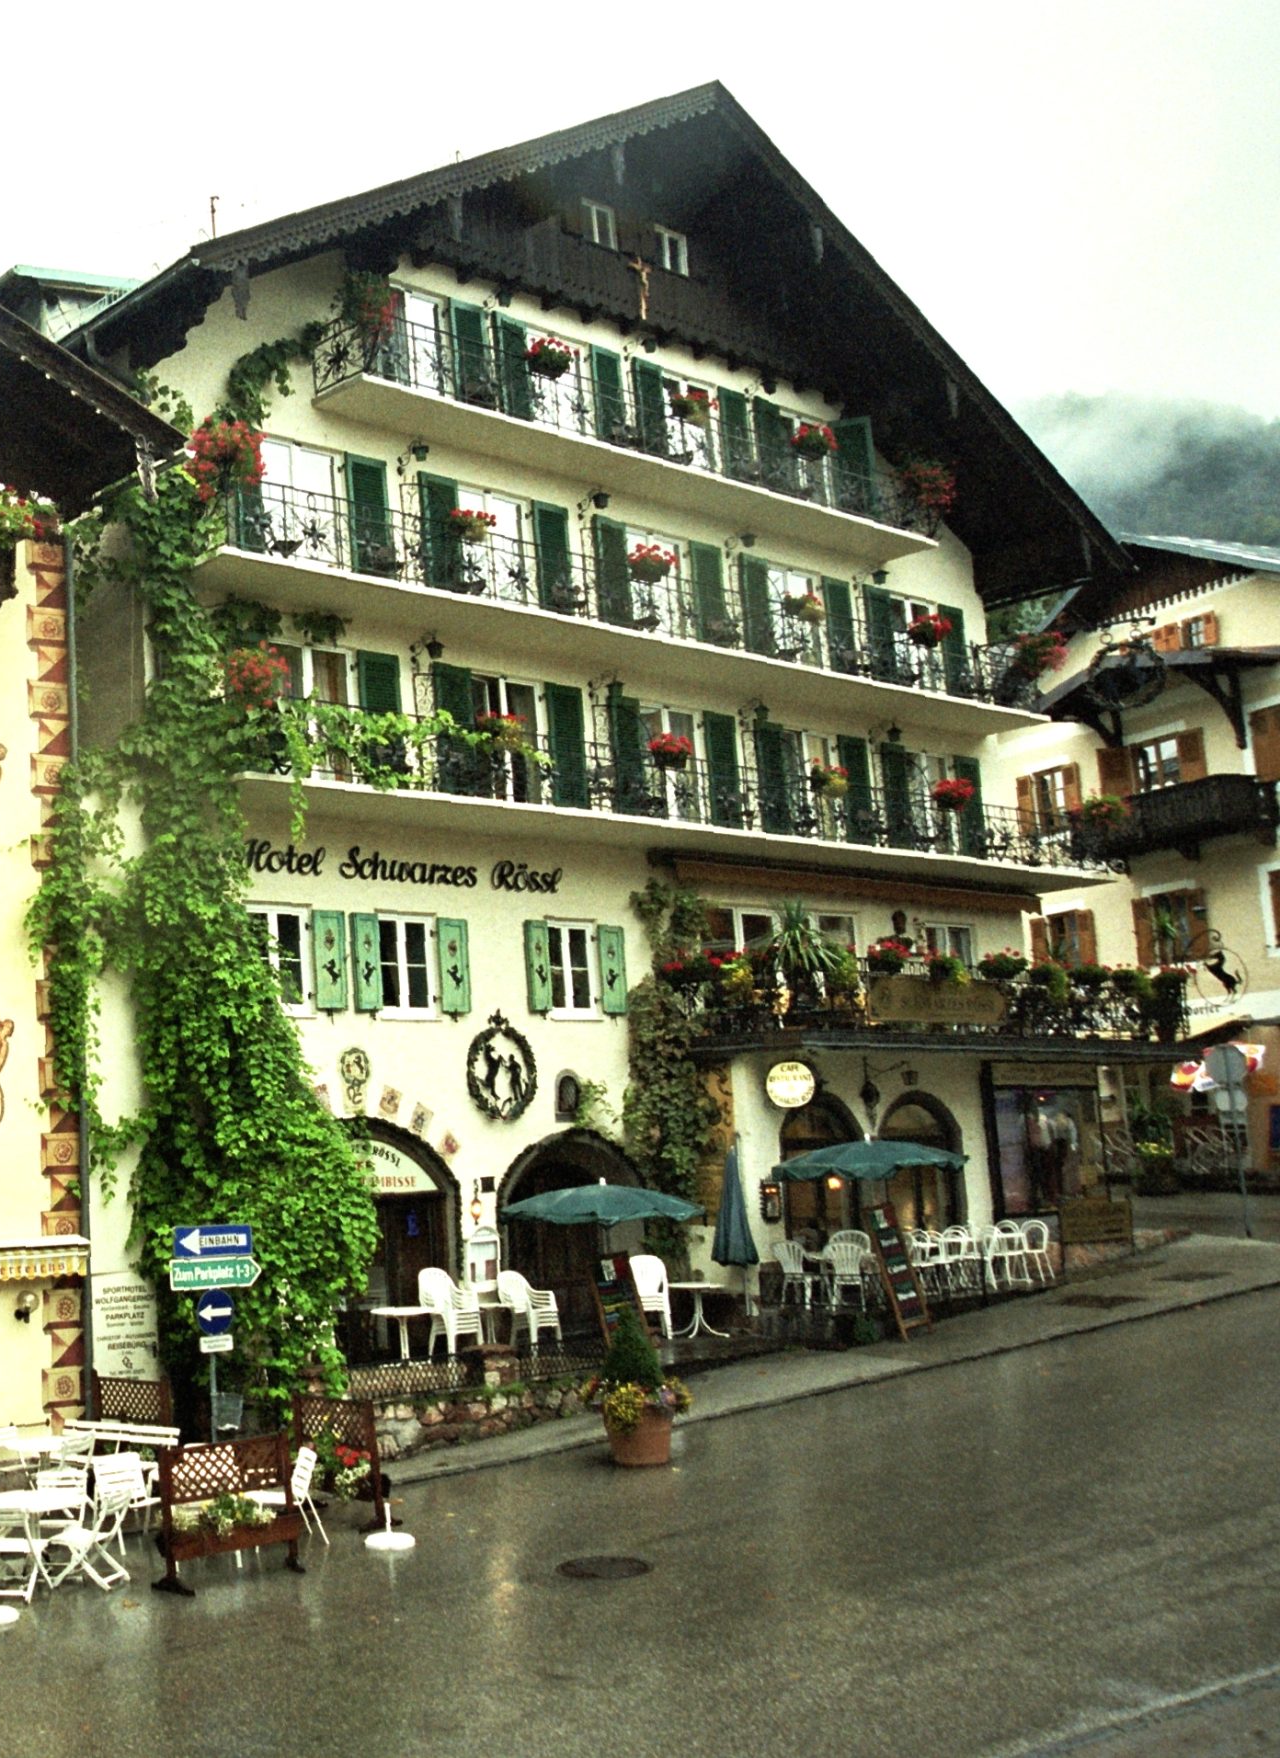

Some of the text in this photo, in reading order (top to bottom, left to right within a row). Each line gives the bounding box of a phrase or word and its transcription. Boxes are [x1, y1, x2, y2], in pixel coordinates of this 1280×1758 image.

[243, 838, 563, 894] Hotel Schwarzes Rössl
[200, 1236, 240, 1247] EINBAHN
[174, 1264, 250, 1283] Zum Parkplatz 1-3
[105, 1312, 144, 1320] PARKPLATZ
